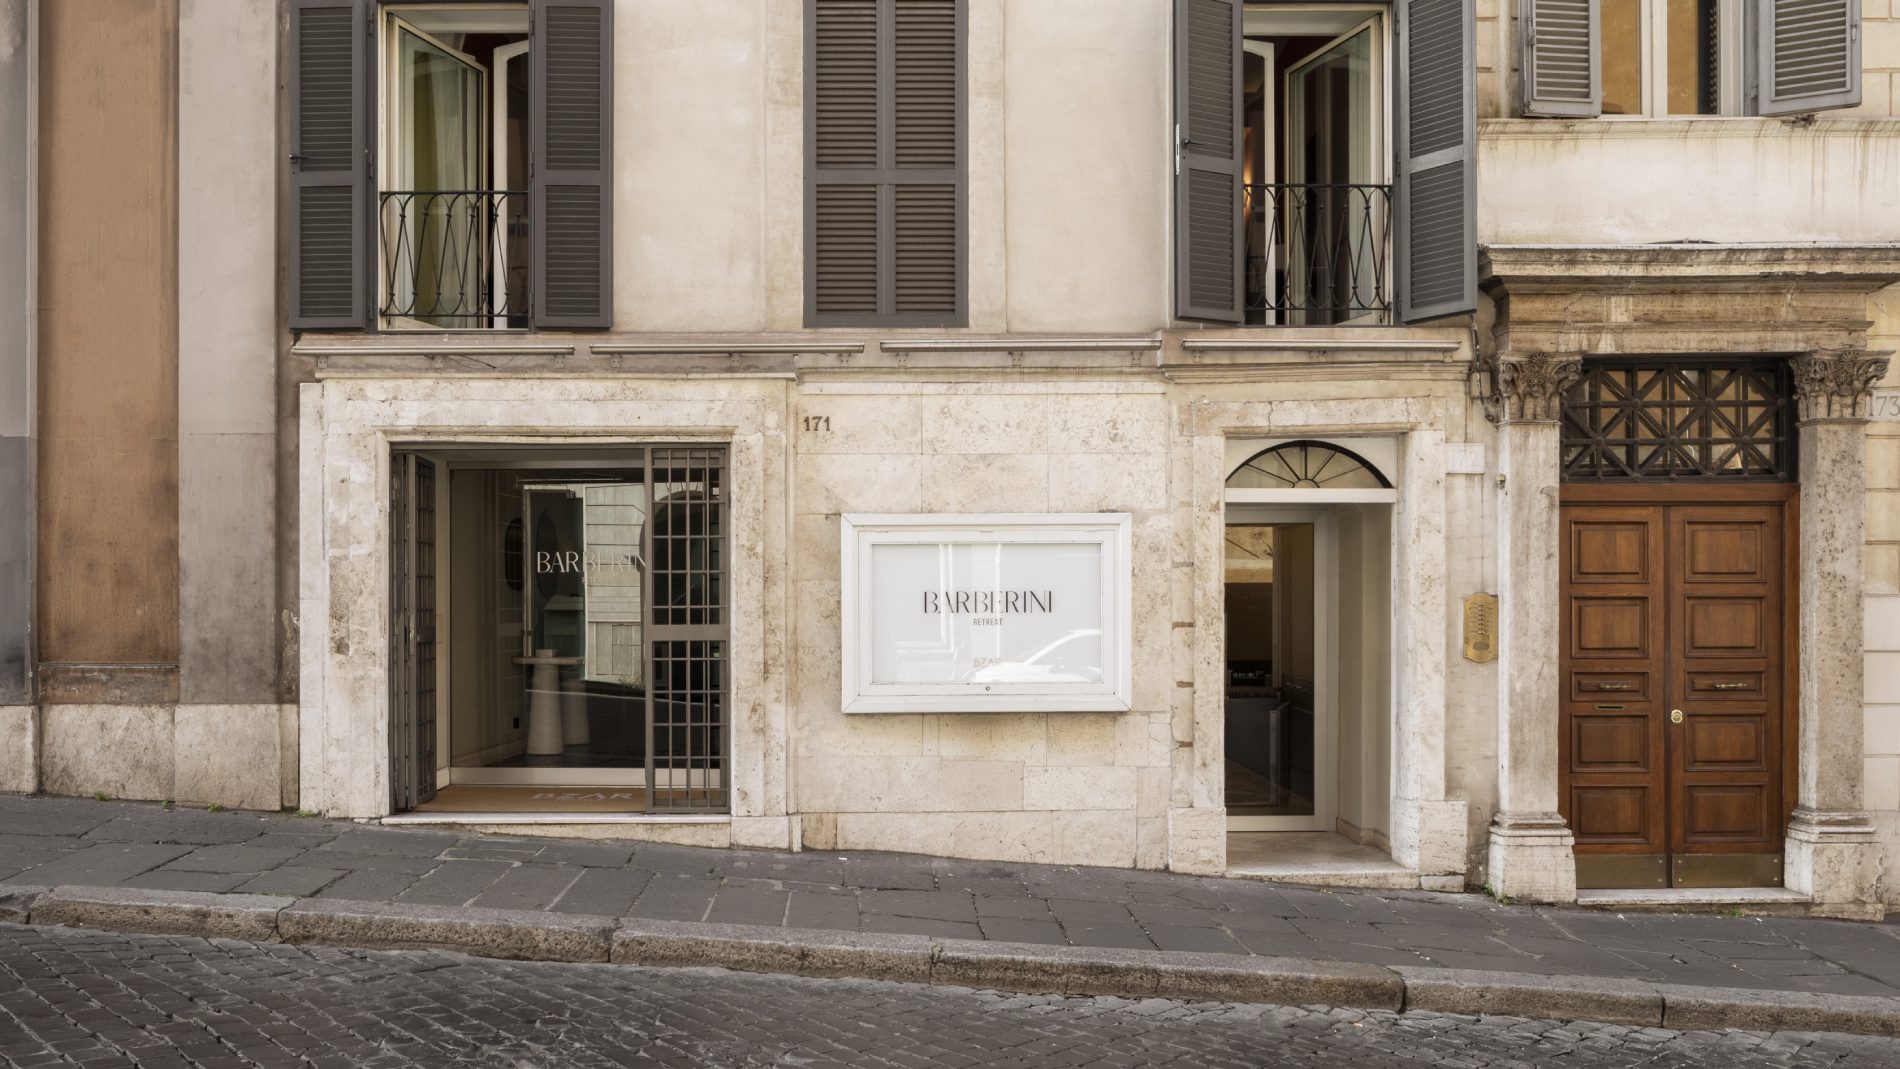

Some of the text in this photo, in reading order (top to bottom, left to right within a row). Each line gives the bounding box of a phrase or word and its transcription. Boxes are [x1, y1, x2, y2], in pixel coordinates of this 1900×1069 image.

[803, 415, 831, 432] 171
[537, 551, 646, 573] BARBERIN
[924, 590, 1052, 613] BARBERINI
[973, 617, 1003, 626] RETREAT
